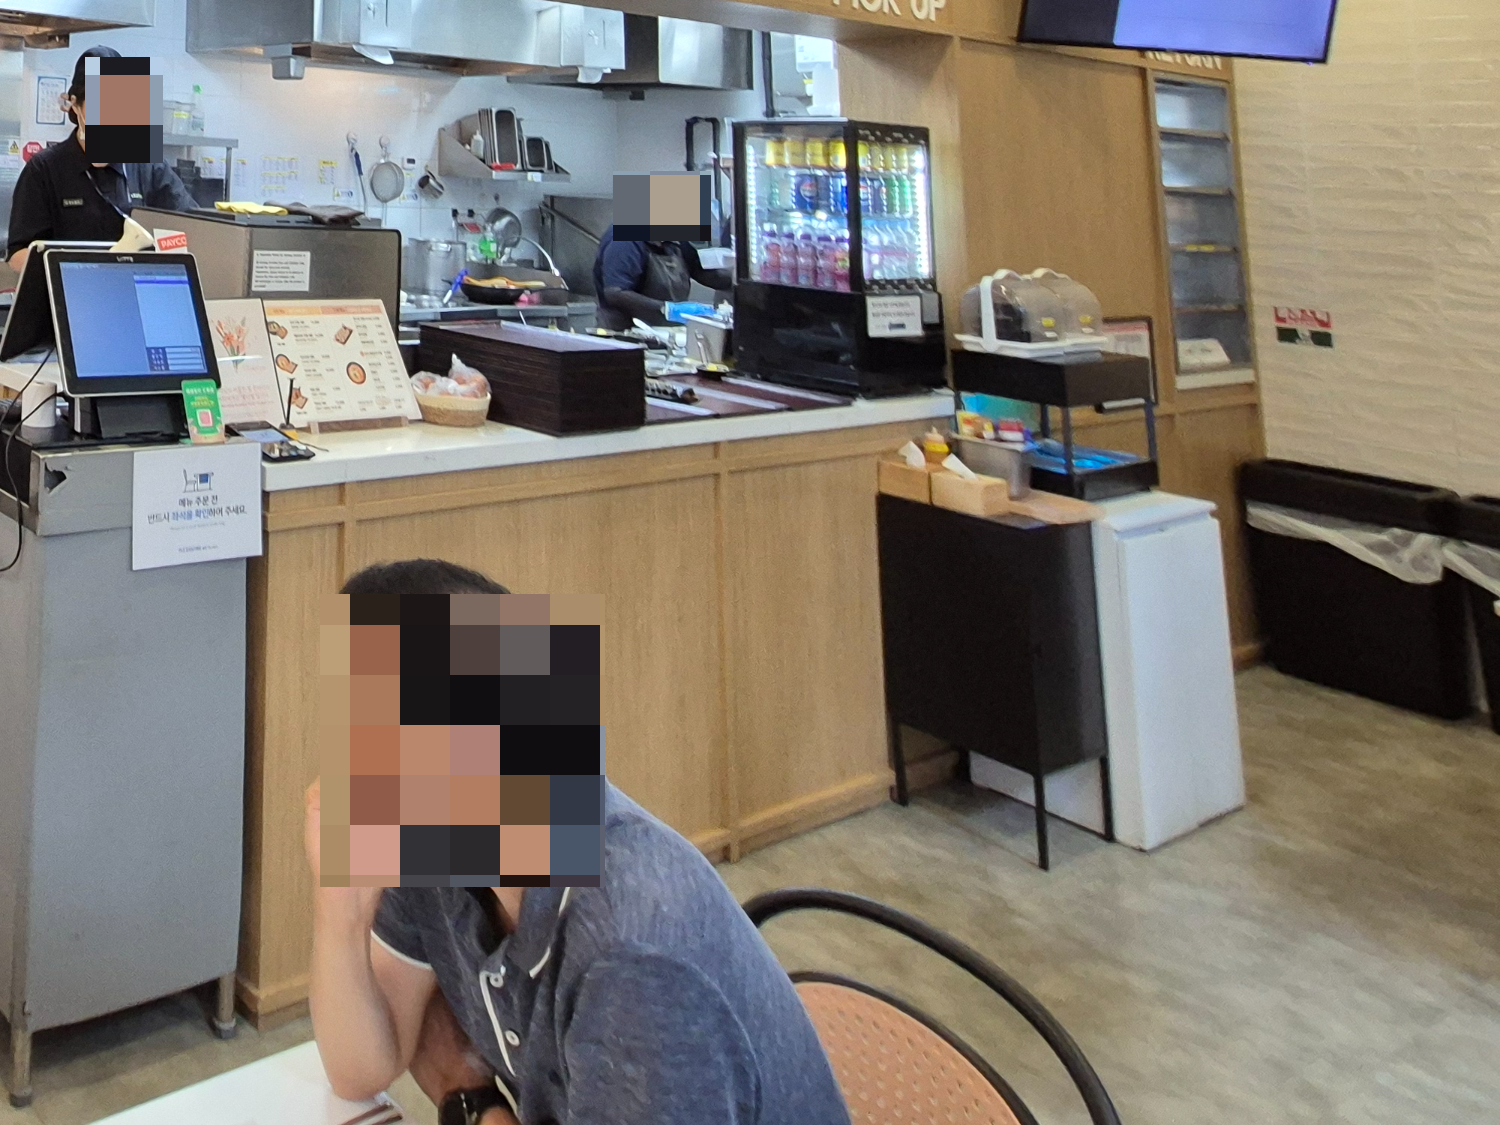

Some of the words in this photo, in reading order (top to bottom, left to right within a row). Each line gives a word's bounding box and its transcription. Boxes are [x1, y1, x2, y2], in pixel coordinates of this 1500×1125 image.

[160, 236, 187, 249] PAYCO
[178, 497, 193, 506] 메뉴
[195, 495, 209, 506] 주문
[211, 495, 218, 504] 전
[147, 512, 170, 524] 반드시
